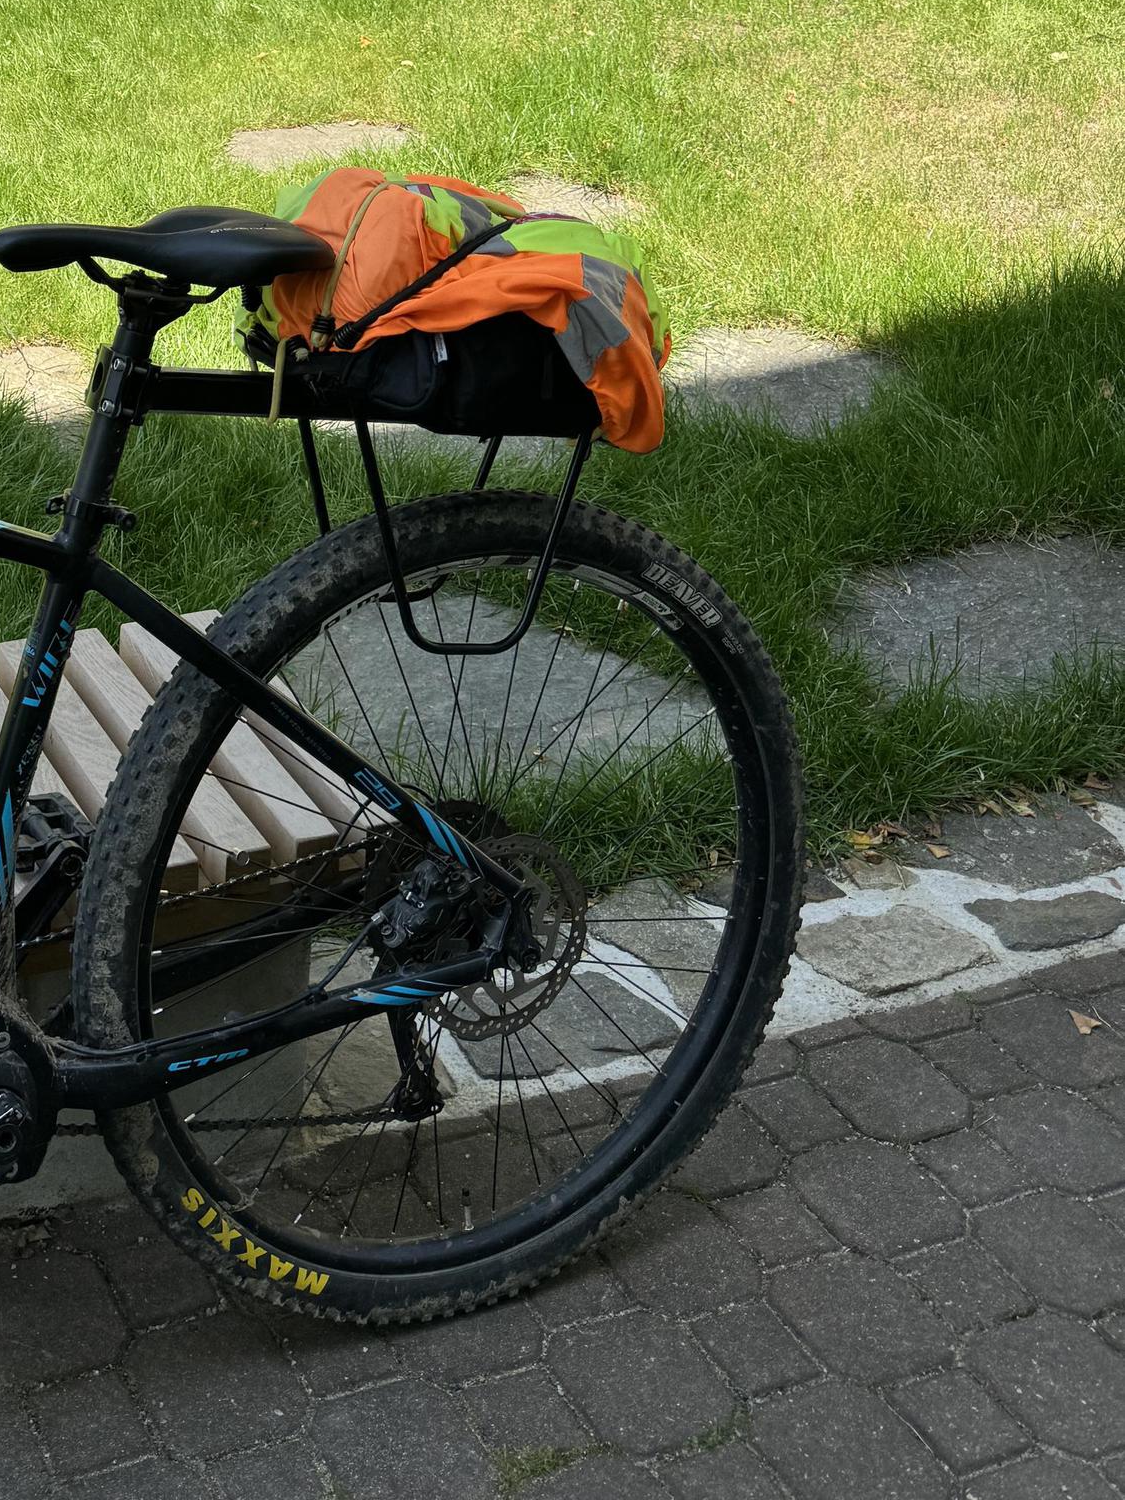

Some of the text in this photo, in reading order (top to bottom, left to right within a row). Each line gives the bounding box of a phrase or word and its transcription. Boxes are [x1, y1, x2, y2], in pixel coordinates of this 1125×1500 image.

[641, 561, 723, 629] BEAVER
[354, 767, 402, 810] 29
[168, 1048, 250, 1072] CTM
[181, 1187, 330, 1296] MAXXIS
